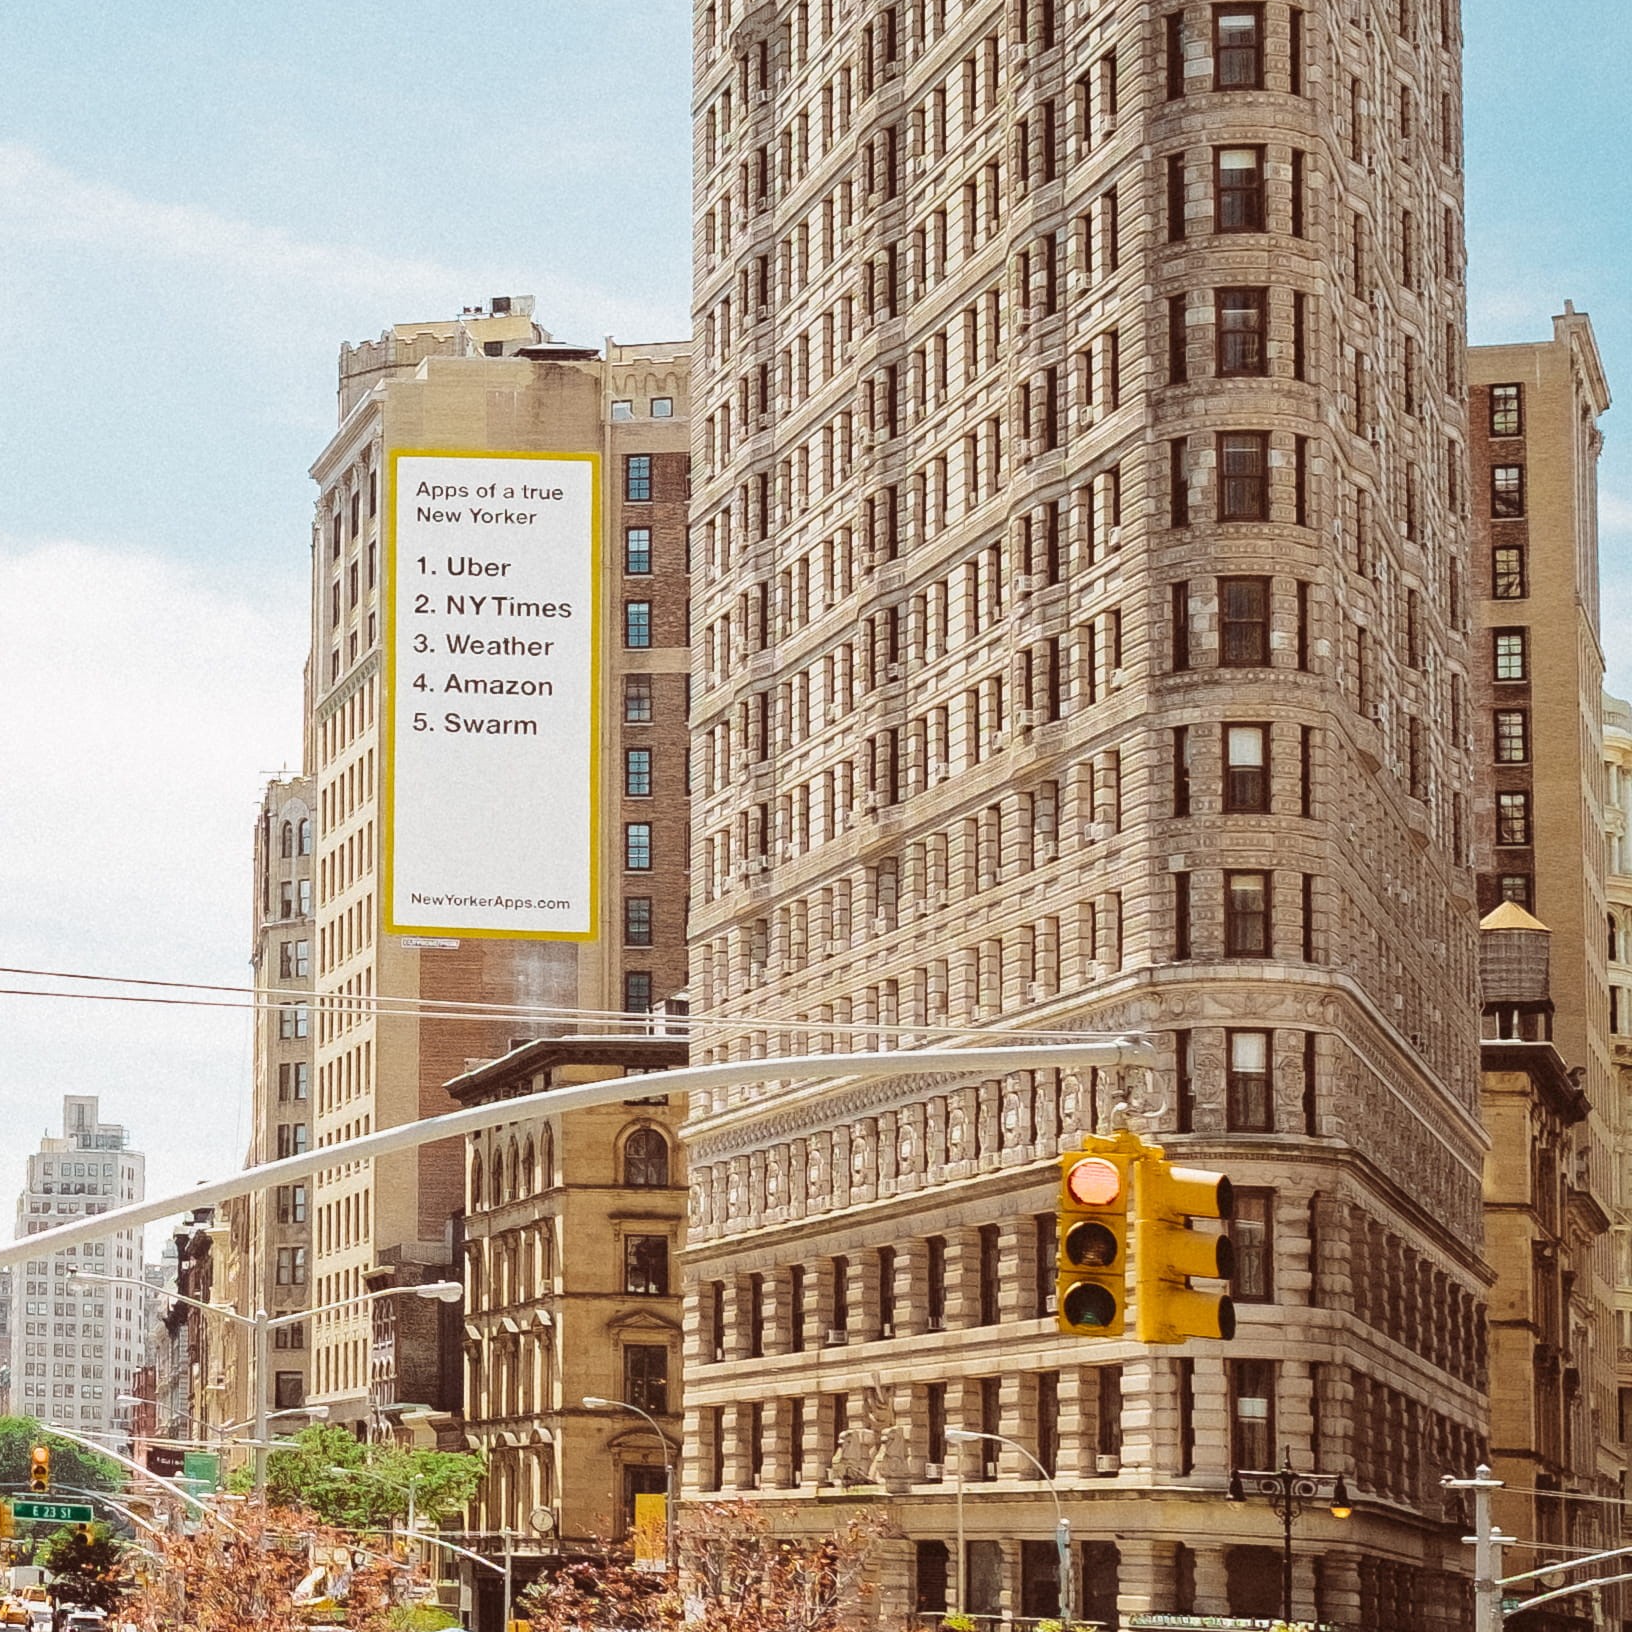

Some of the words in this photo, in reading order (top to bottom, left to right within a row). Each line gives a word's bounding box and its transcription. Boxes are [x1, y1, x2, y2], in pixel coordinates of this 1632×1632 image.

[416, 481, 469, 500] Apps
[476, 483, 496, 498] of
[503, 487, 515, 499] a
[522, 484, 564, 500] true
[416, 507, 461, 523] New
[469, 508, 537, 524] Yorker
[417, 556, 437, 575] 1.
[447, 556, 511, 577] Uber
[414, 594, 436, 614] 2.
[413, 634, 435, 653] 3.
[446, 634, 554, 656] Weather
[413, 673, 434, 693] 4.
[444, 674, 553, 696] Amazon
[413, 713, 434, 732] 5.
[445, 713, 537, 735] Swarm
[411, 893, 570, 910] NewYorkerApps.com
[32, 1506, 39, 1517] E
[43, 1506, 56, 1518] 23
[60, 1507, 71, 1519] St
